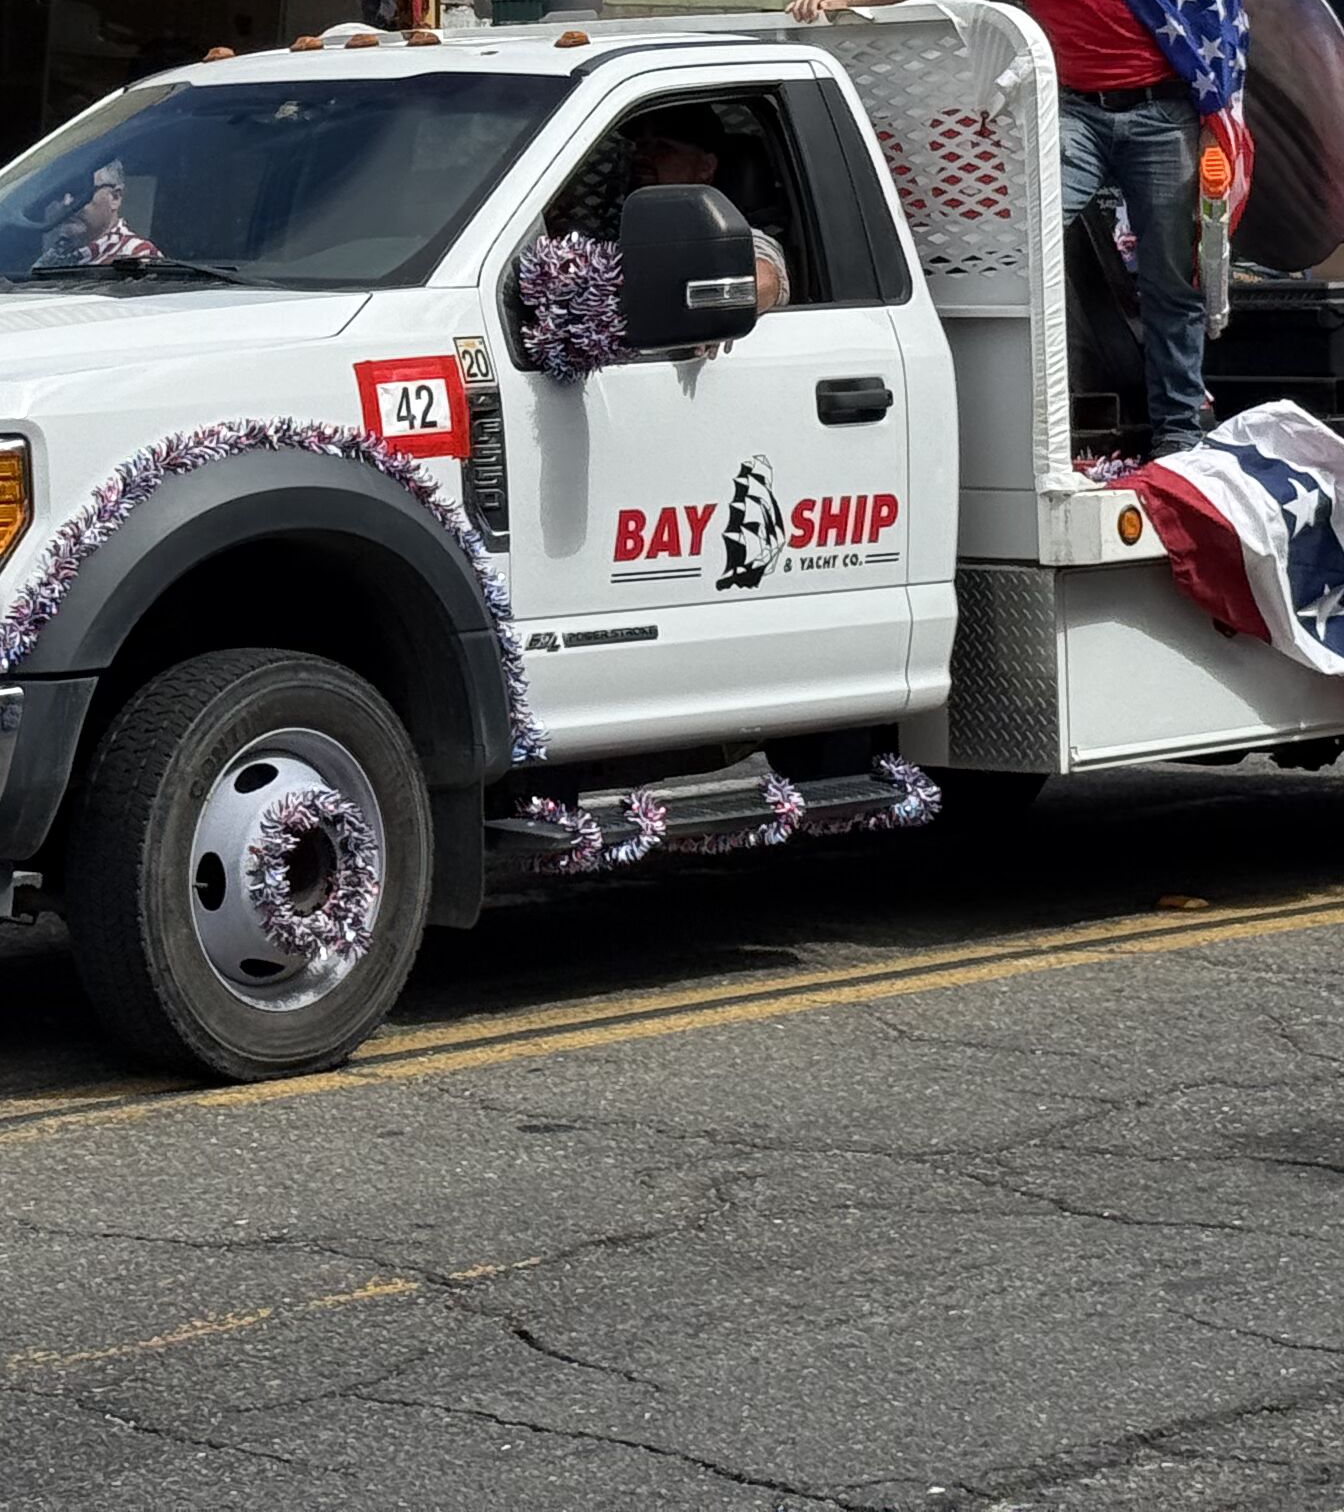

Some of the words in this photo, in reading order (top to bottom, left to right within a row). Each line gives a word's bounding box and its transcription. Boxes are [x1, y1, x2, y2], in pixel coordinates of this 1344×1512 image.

[462, 349, 489, 378] 20
[396, 384, 438, 430] 42
[613, 503, 718, 562] BAY
[787, 493, 899, 549] SHIP
[783, 557, 793, 573] &
[800, 554, 838, 571] YACHT
